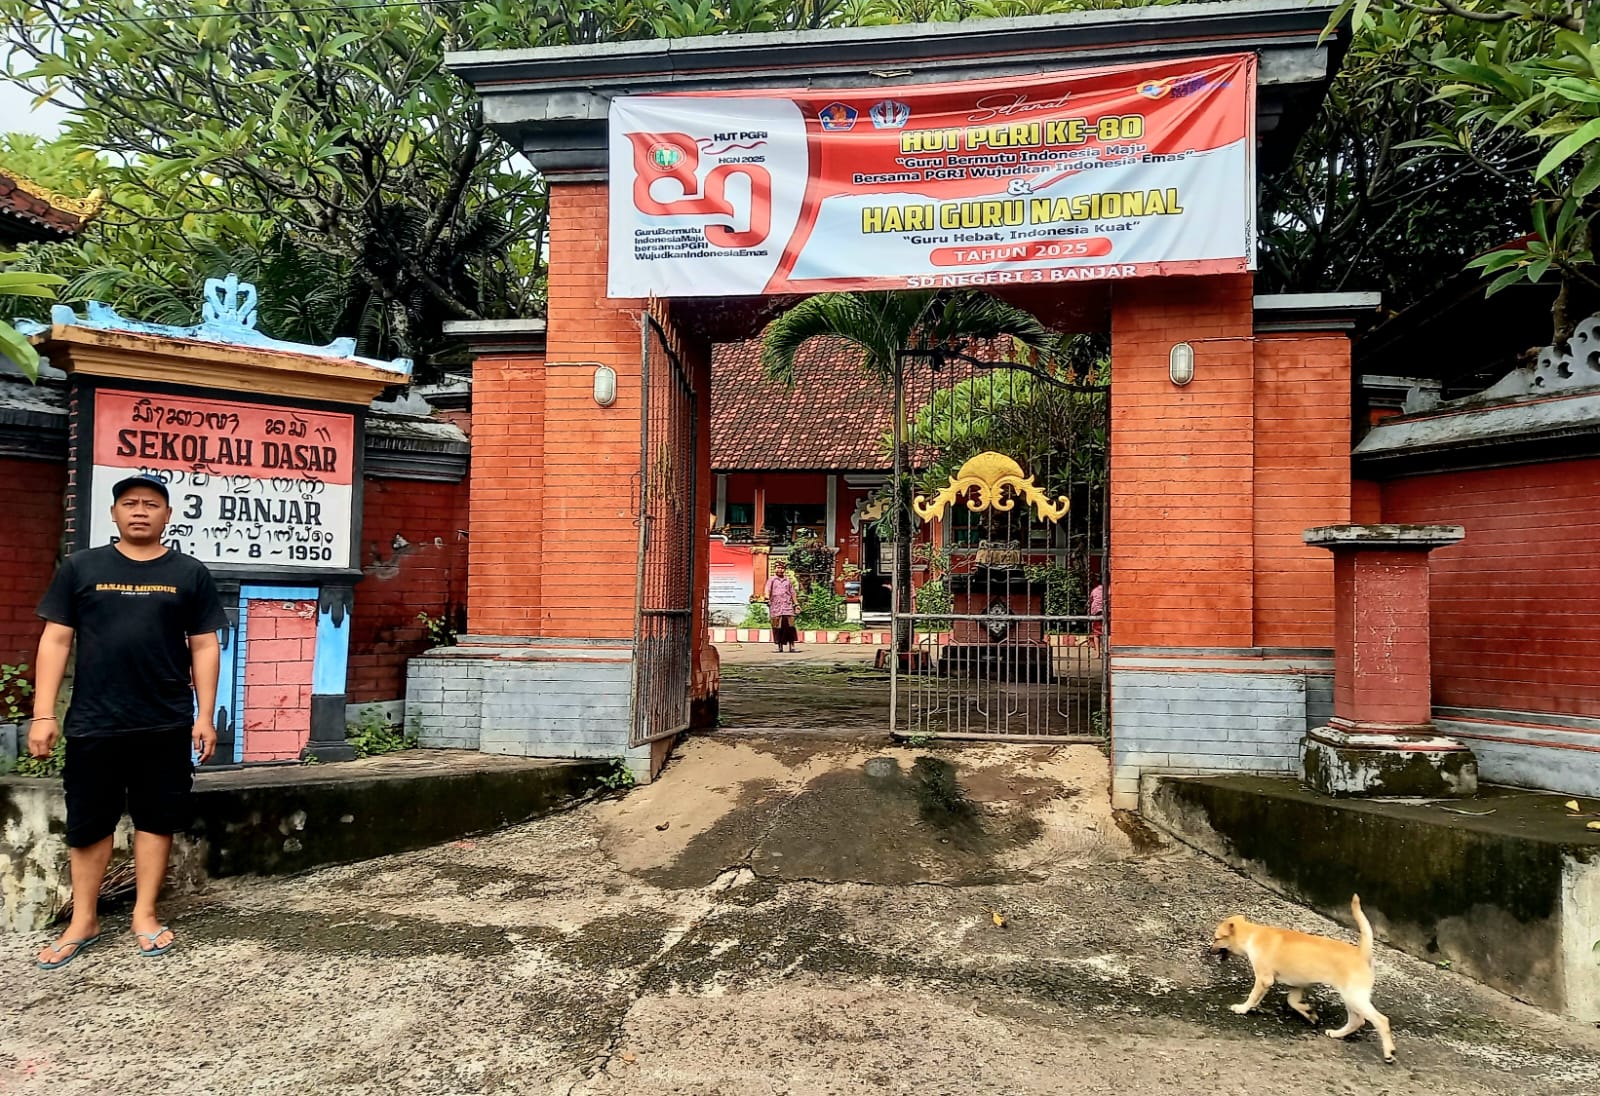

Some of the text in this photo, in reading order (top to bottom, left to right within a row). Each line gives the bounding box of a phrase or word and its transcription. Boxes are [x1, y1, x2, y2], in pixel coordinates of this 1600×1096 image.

[714, 131, 768, 142] HUT PGRI
[901, 114, 1144, 152] HUT PGRI KE-80
[948, 153, 1015, 166] Bermutu
[1020, 149, 1100, 162] Indonesia
[1105, 144, 1146, 157] Maju
[853, 172, 920, 184] Bersama
[925, 169, 966, 180] PGRI
[970, 165, 1050, 180] Wujudkan
[1055, 156, 1137, 171] Indonesia
[1007, 178, 1033, 195] &
[862, 187, 1184, 233] HARI GURU NASIONAL
[953, 232, 1005, 243] Hebat,
[1010, 225, 1089, 240] Indonesia
[954, 242, 1088, 262] TAHUN 2025
[907, 265, 1136, 288] SD NEGERI 3 BANJAR
[116, 429, 338, 473] SEKOLAH DASAR
[183, 494, 323, 526] 3 BANJAR
